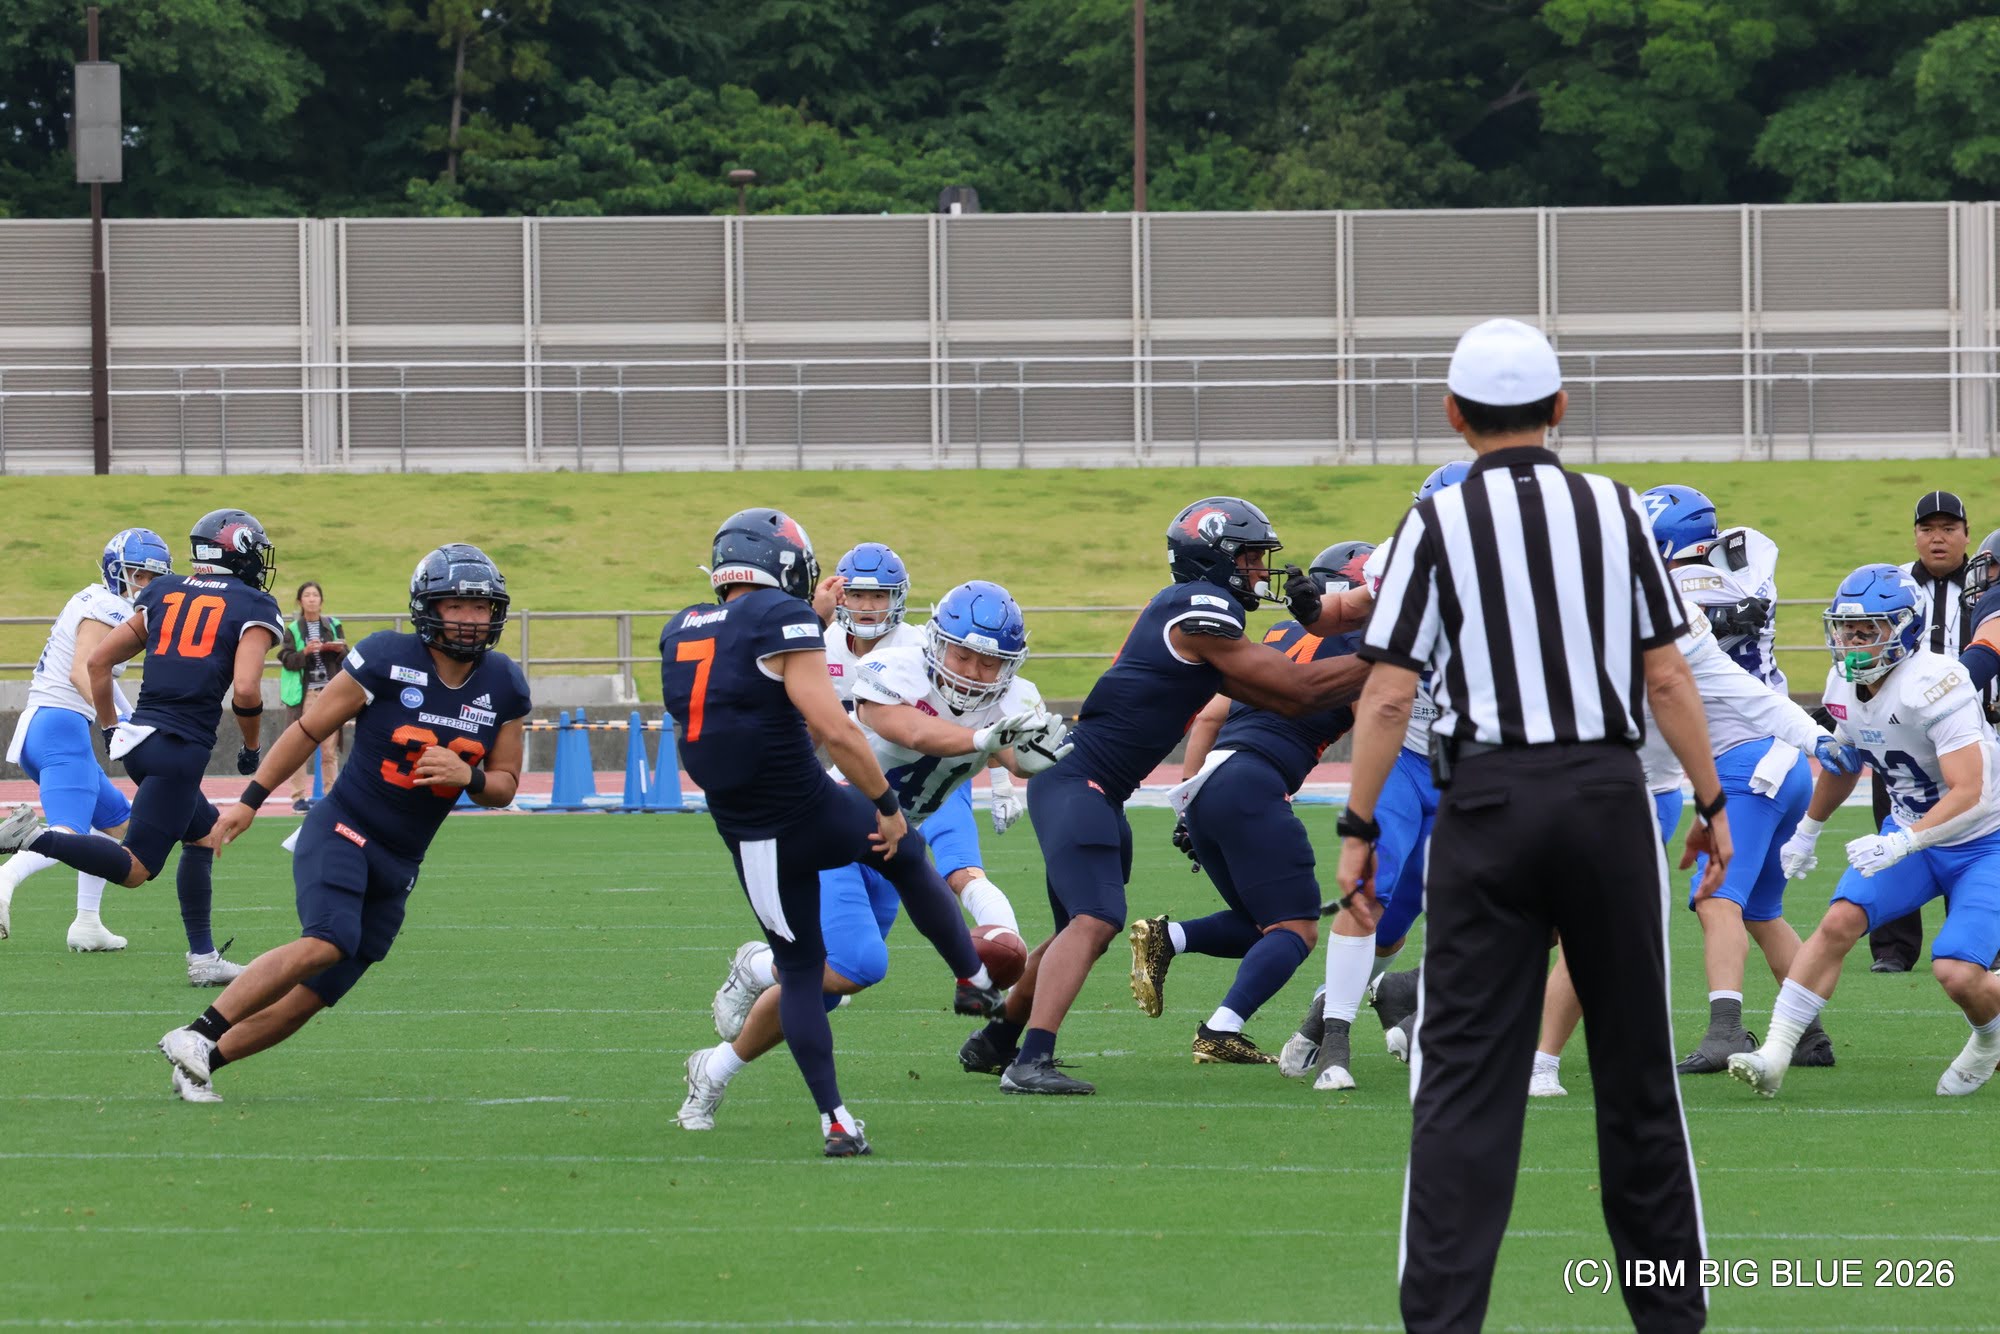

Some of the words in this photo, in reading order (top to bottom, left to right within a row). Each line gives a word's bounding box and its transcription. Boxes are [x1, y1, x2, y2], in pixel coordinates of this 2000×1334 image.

[712, 570, 754, 584] Riddell
[154, 591, 227, 658] 10
[676, 637, 716, 742] 7
[472, 699, 493, 710] adidas
[420, 713, 479, 732] OVERRIDE
[1859, 729, 1885, 744] IBM
[885, 755, 973, 813] 41
[335, 823, 367, 848] J:COM
